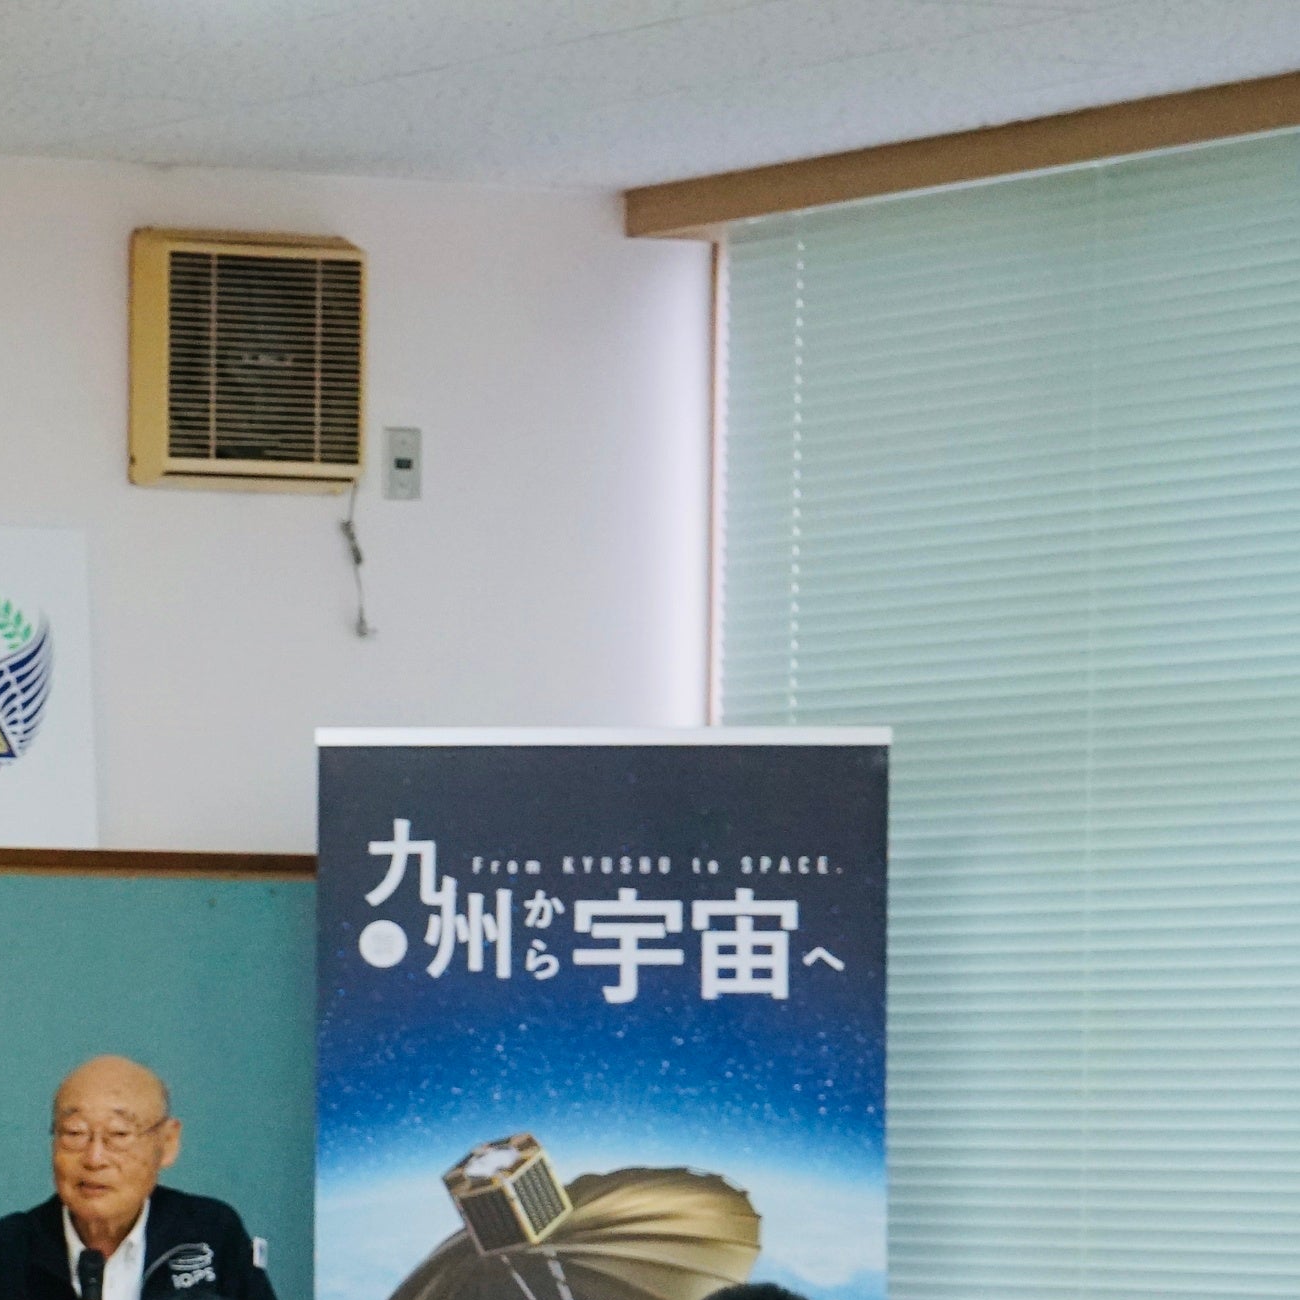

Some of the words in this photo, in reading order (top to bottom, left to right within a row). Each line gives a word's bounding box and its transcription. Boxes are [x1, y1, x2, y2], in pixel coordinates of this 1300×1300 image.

[471, 855, 541, 875] From
[561, 855, 672, 875] KYUSHU
[691, 856, 720, 875] to
